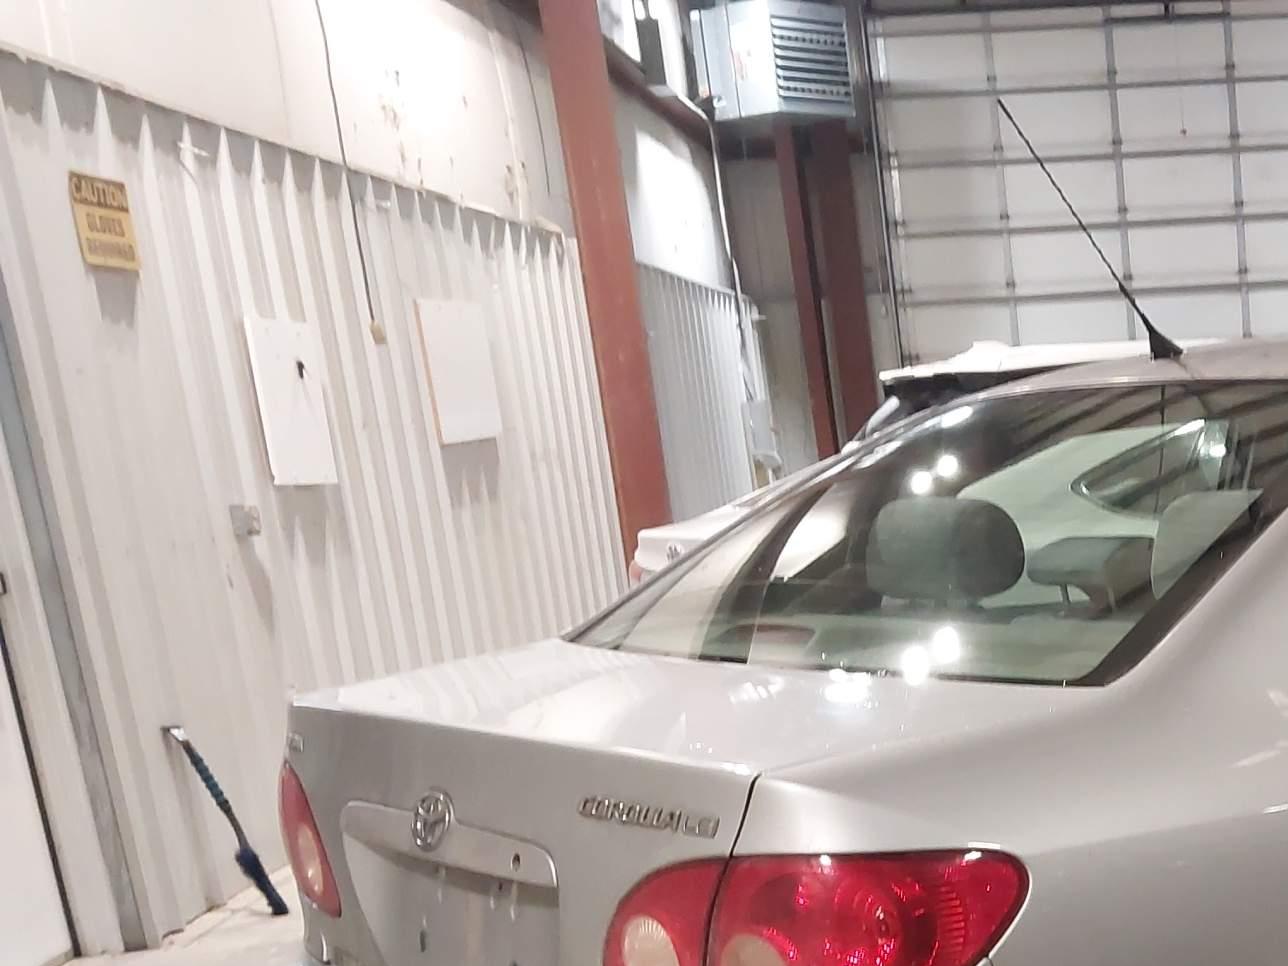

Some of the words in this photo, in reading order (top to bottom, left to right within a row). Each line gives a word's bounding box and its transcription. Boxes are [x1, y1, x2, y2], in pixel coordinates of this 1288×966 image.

[71, 176, 128, 209] CAUTION
[86, 212, 125, 237] GLOVES
[578, 796, 682, 833] COROLLA
[681, 815, 720, 839] LE
